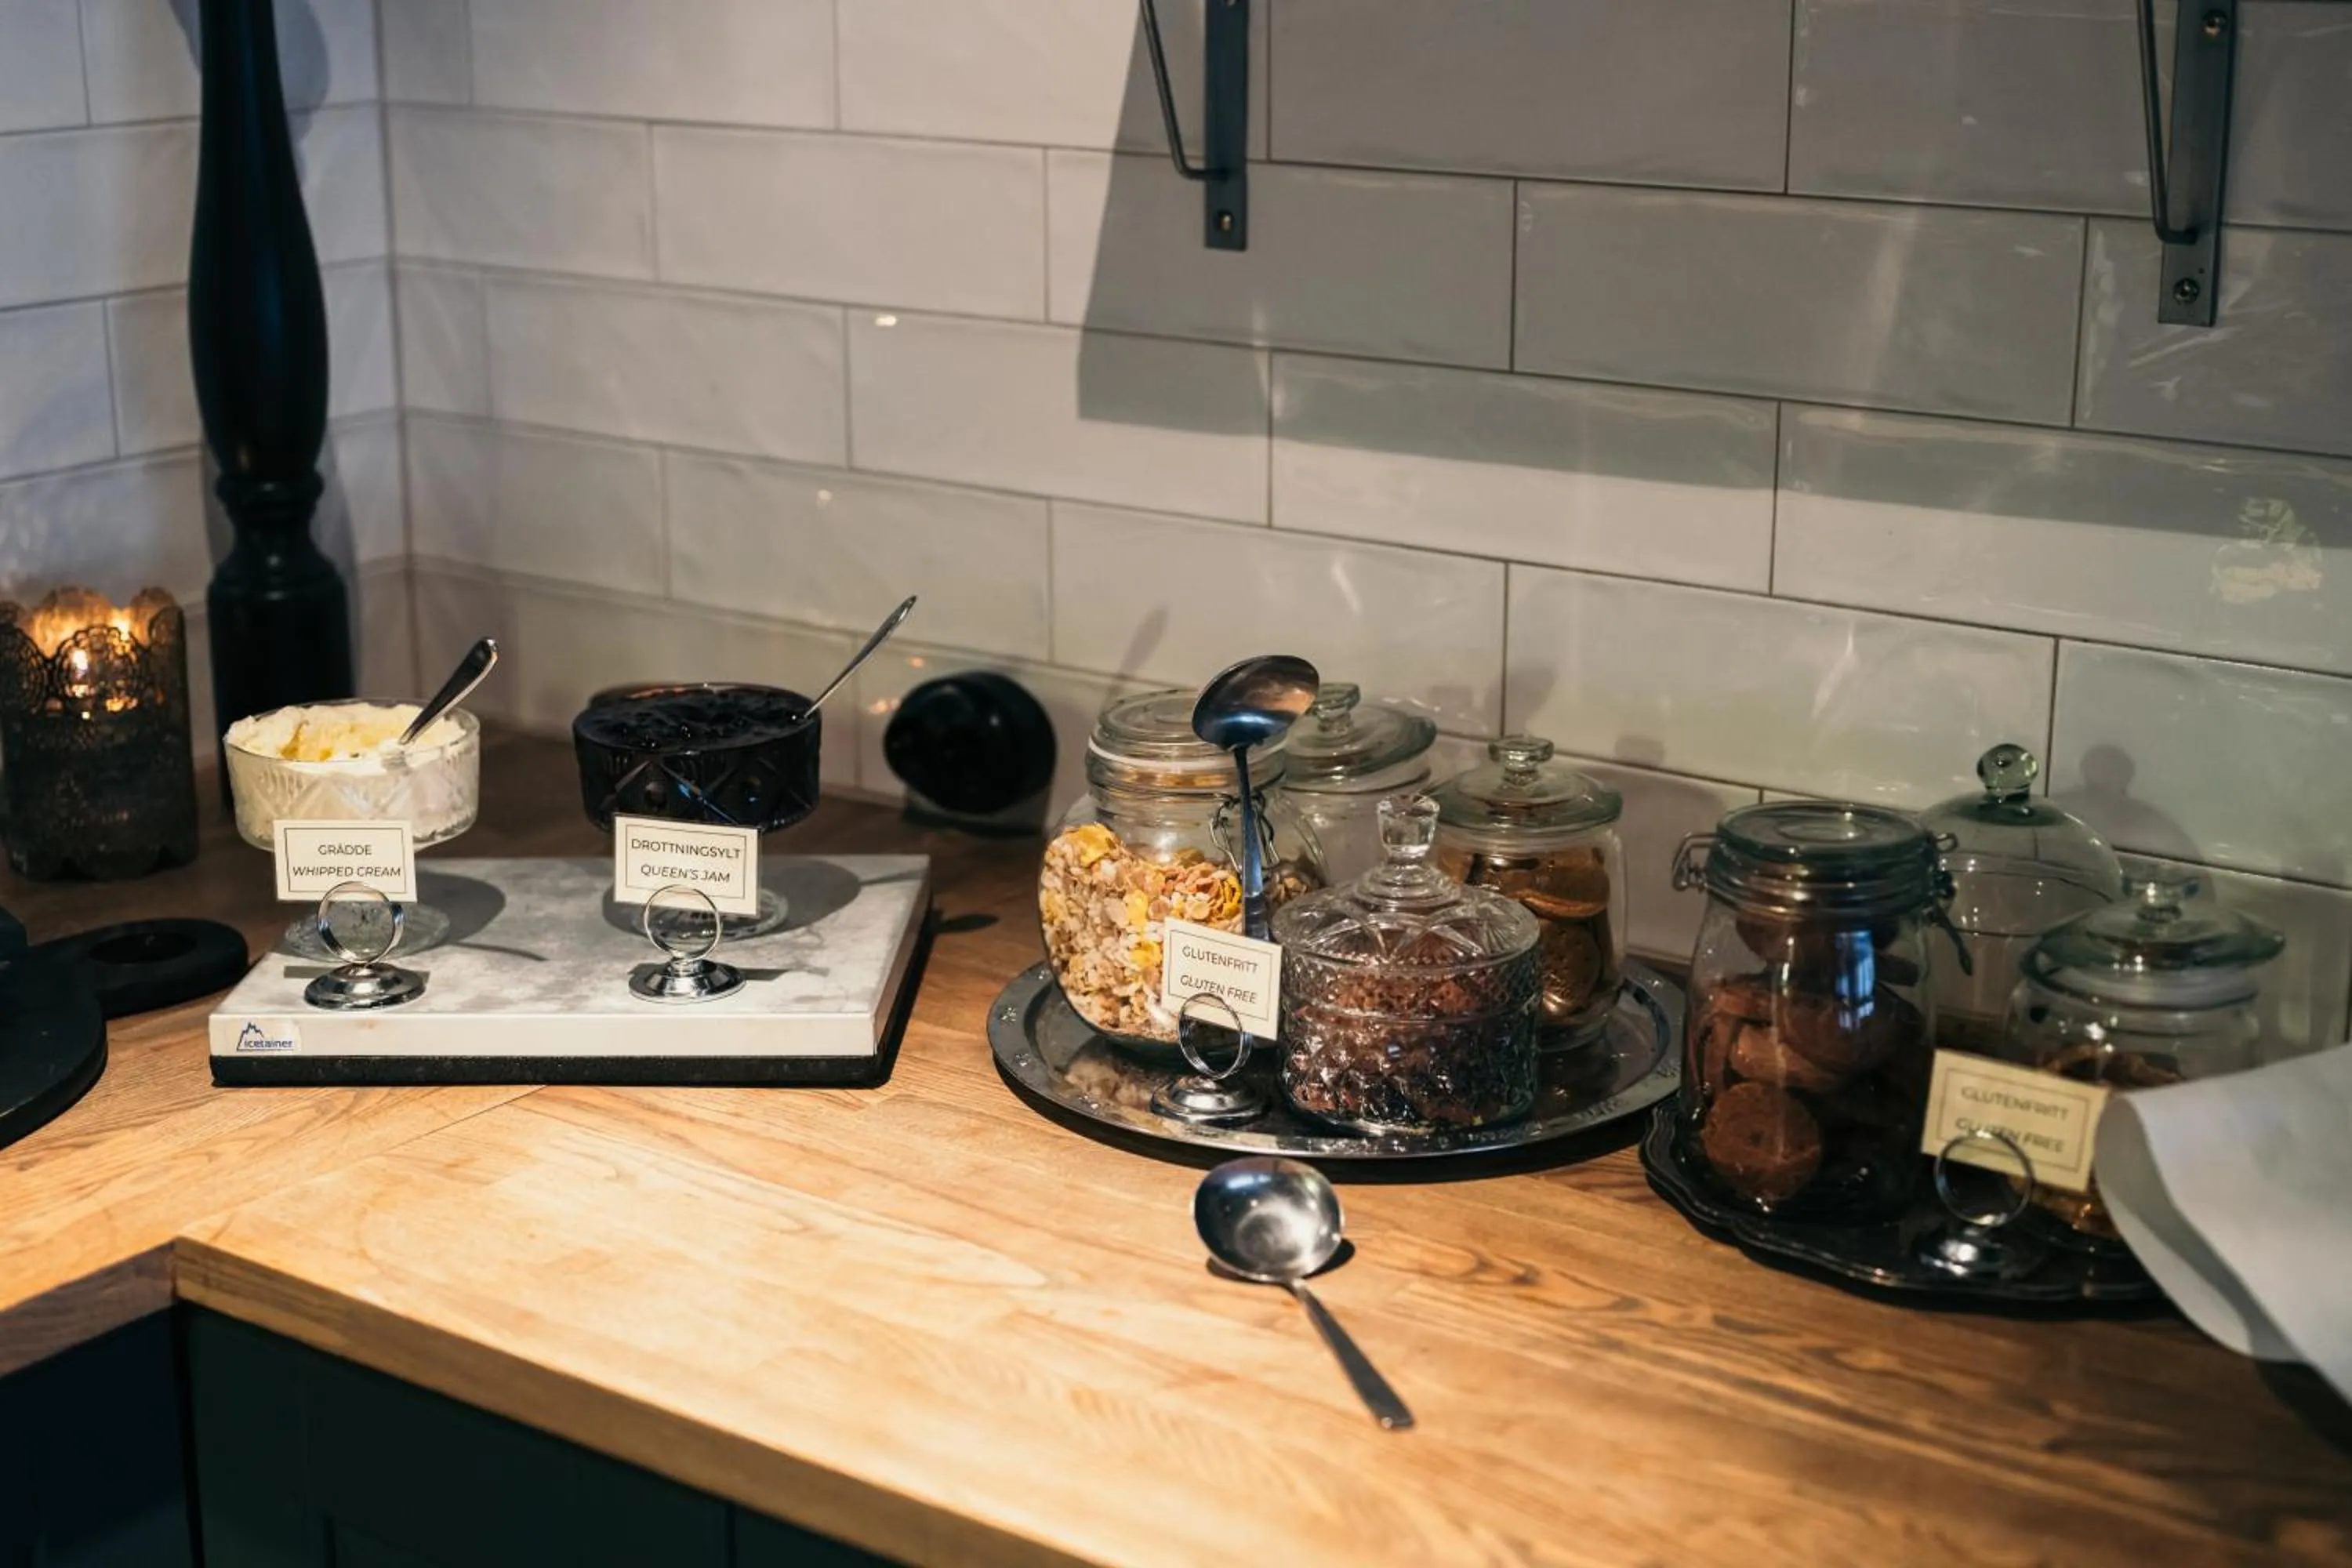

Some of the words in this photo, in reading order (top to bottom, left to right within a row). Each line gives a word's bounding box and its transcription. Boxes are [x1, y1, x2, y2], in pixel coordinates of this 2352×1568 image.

[630, 838, 741, 859] DROTTNINGSYLT
[292, 866, 354, 877] WHIPPED
[357, 866, 401, 877] CREAM
[641, 864, 699, 880] QUEEN'S
[699, 869, 730, 883] JAM
[1181, 945, 1258, 975] GLUTENFRITT
[1180, 975, 1225, 995] GLUTEN
[1227, 987, 1258, 1004] FREE
[244, 1040, 292, 1048] icetainer
[1961, 1086, 2068, 1120] GLUTENFRITT
[2024, 1131, 2064, 1153] FREE
